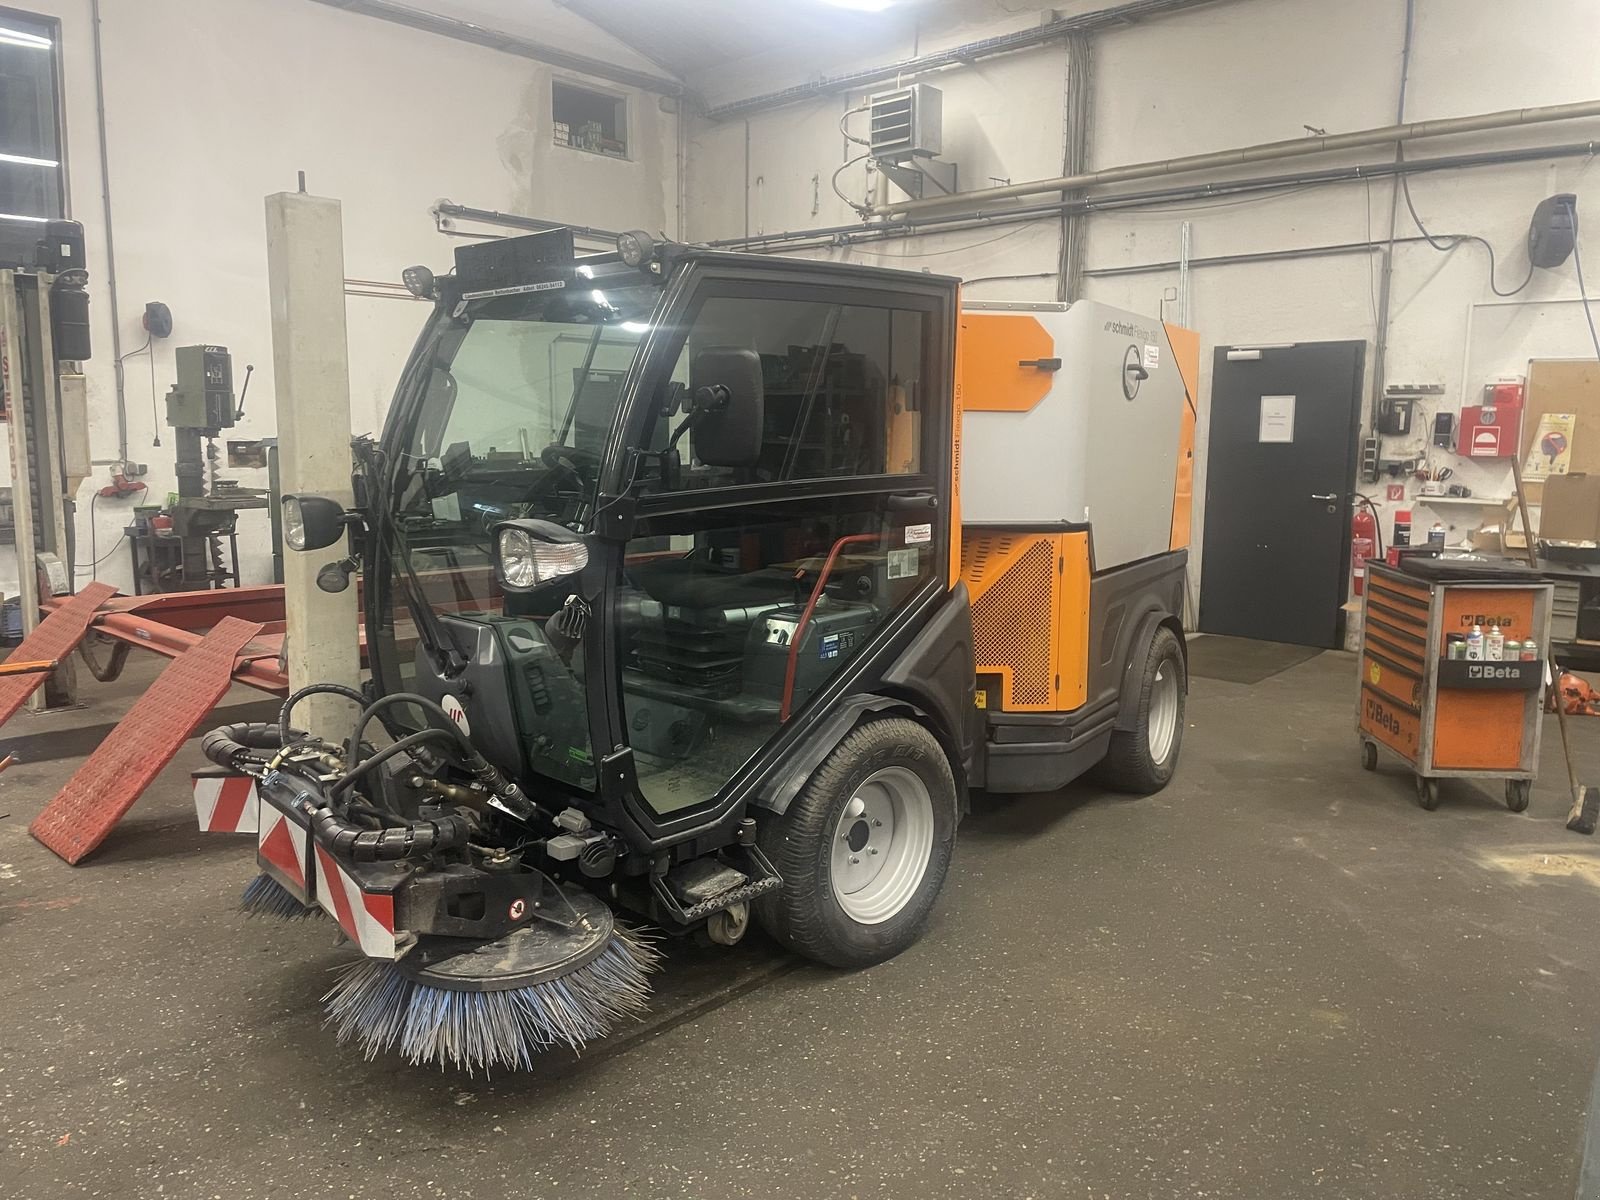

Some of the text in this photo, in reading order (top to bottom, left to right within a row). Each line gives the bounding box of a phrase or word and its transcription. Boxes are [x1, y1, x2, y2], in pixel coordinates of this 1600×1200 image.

[1112, 320, 1134, 337] schmidt
[1475, 615, 1512, 627] Beta
[1484, 666, 1521, 679] Beta
